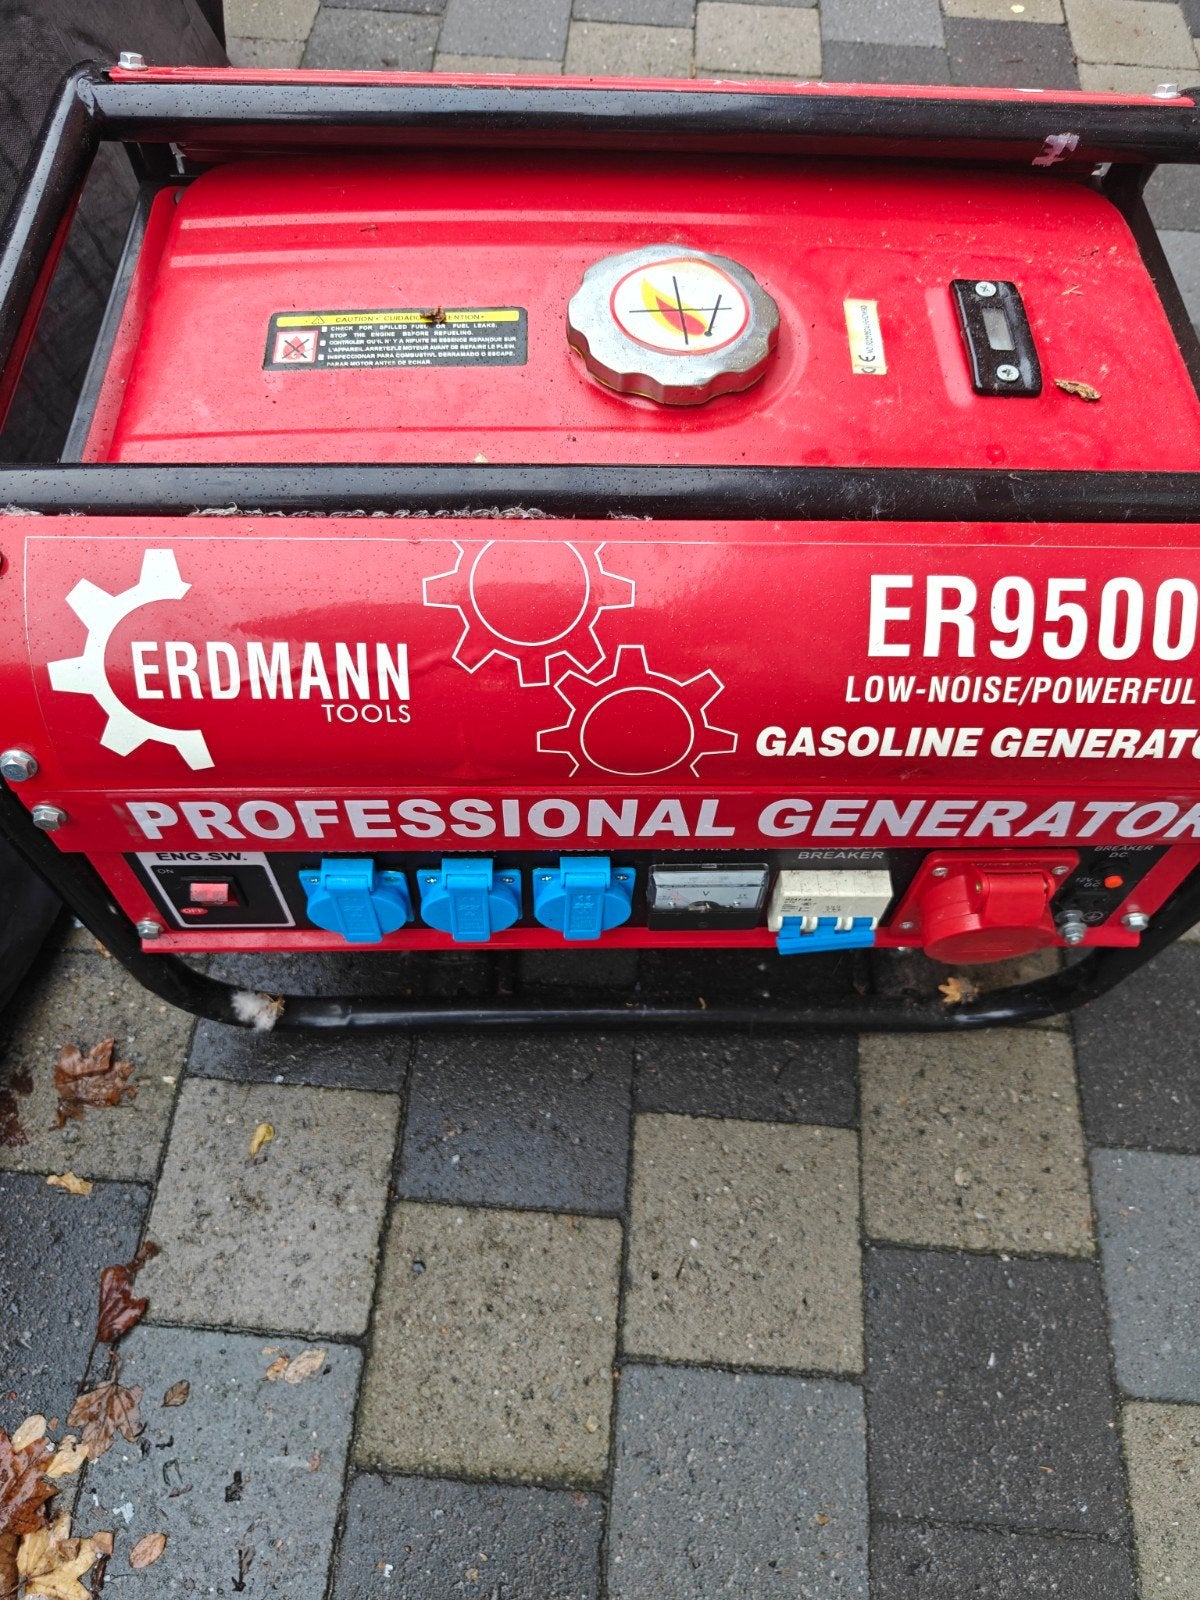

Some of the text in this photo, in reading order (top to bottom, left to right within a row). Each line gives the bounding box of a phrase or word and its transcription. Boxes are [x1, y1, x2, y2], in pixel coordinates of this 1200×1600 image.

[867, 574, 1199, 661] ER9500
[131, 641, 410, 701] ERDMANN
[845, 675, 1197, 705] LOW-NOISE/POWERFUL
[321, 704, 411, 724] TOOLS
[755, 726, 1200, 760] GASOLINE GENERAT
[125, 799, 736, 840] PROFESSIONAL
[798, 852, 885, 860] BREAKER
